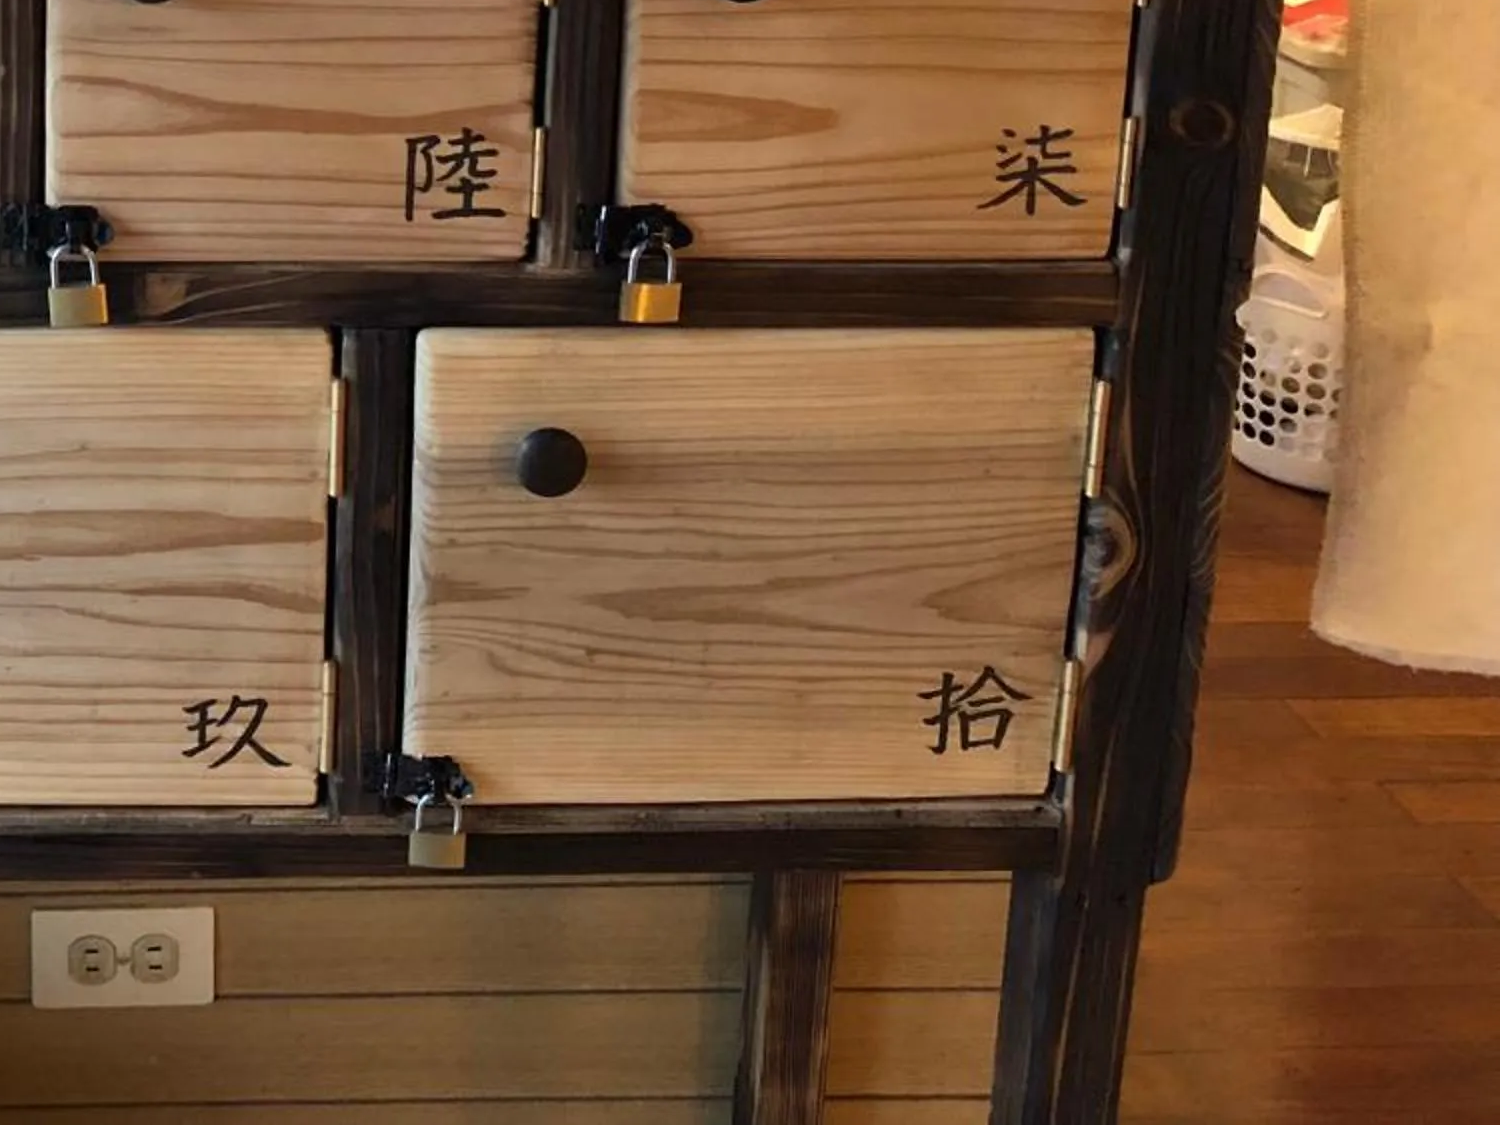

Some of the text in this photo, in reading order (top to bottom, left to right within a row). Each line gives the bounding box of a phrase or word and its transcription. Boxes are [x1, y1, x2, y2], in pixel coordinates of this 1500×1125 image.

[406, 128, 504, 222] 陸
[977, 124, 1087, 216] 柒
[183, 694, 290, 769] 玖
[917, 665, 1031, 755] 拾
